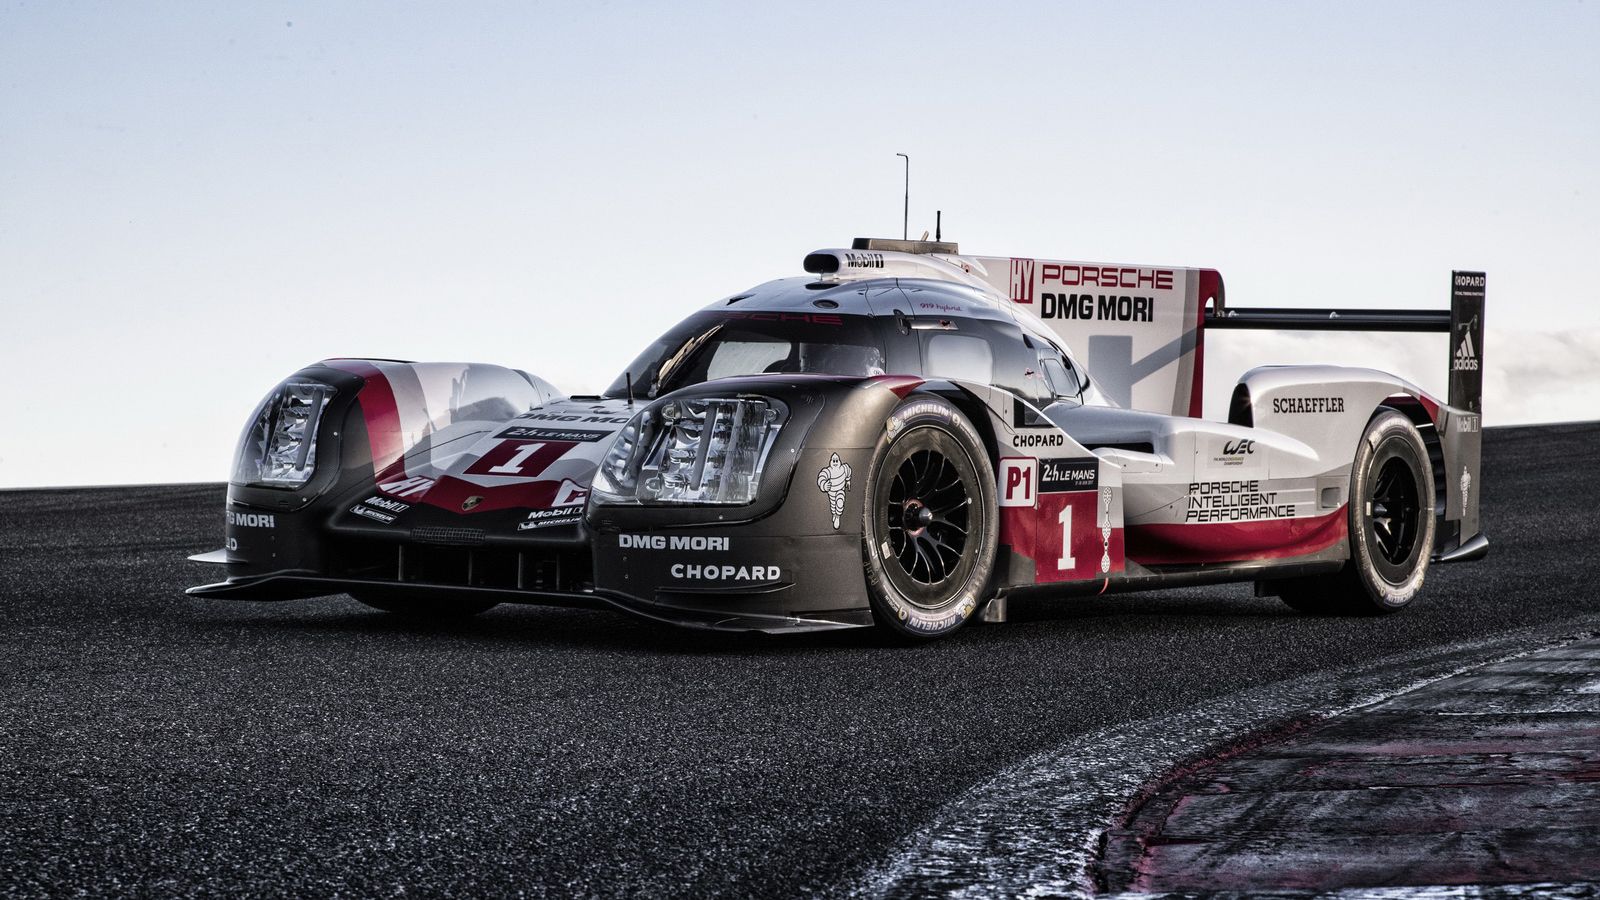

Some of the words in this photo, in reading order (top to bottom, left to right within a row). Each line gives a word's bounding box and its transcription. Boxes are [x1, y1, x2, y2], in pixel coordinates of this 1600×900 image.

[1010, 258, 1034, 303] HY
[1042, 264, 1173, 290] PORSCHE
[1041, 293, 1094, 320] DMG
[1098, 294, 1154, 322] MORI
[1454, 356, 1478, 371] adidas
[903, 403, 949, 420] MICHELIN
[1273, 397, 1345, 413] SCHAEFFLER
[580, 416, 630, 424] MO
[1013, 434, 1064, 447] CHOPARD
[1223, 439, 1255, 454] WEC
[488, 442, 546, 474] 1
[1006, 466, 1032, 500] P1
[1060, 470, 1071, 481] LE
[1071, 469, 1095, 480] MANS
[1189, 480, 1259, 495] PORSCHE
[1188, 492, 1277, 509] INTELLIGENT
[236, 512, 275, 528] MORI
[528, 507, 573, 519] Mobil
[1186, 505, 1295, 522] PERFORMANCE
[619, 534, 666, 550] DMG
[670, 535, 730, 551] MORI
[1057, 504, 1076, 570] 1
[671, 563, 781, 581] CHOPARD
[909, 615, 957, 631] MICHELIN
